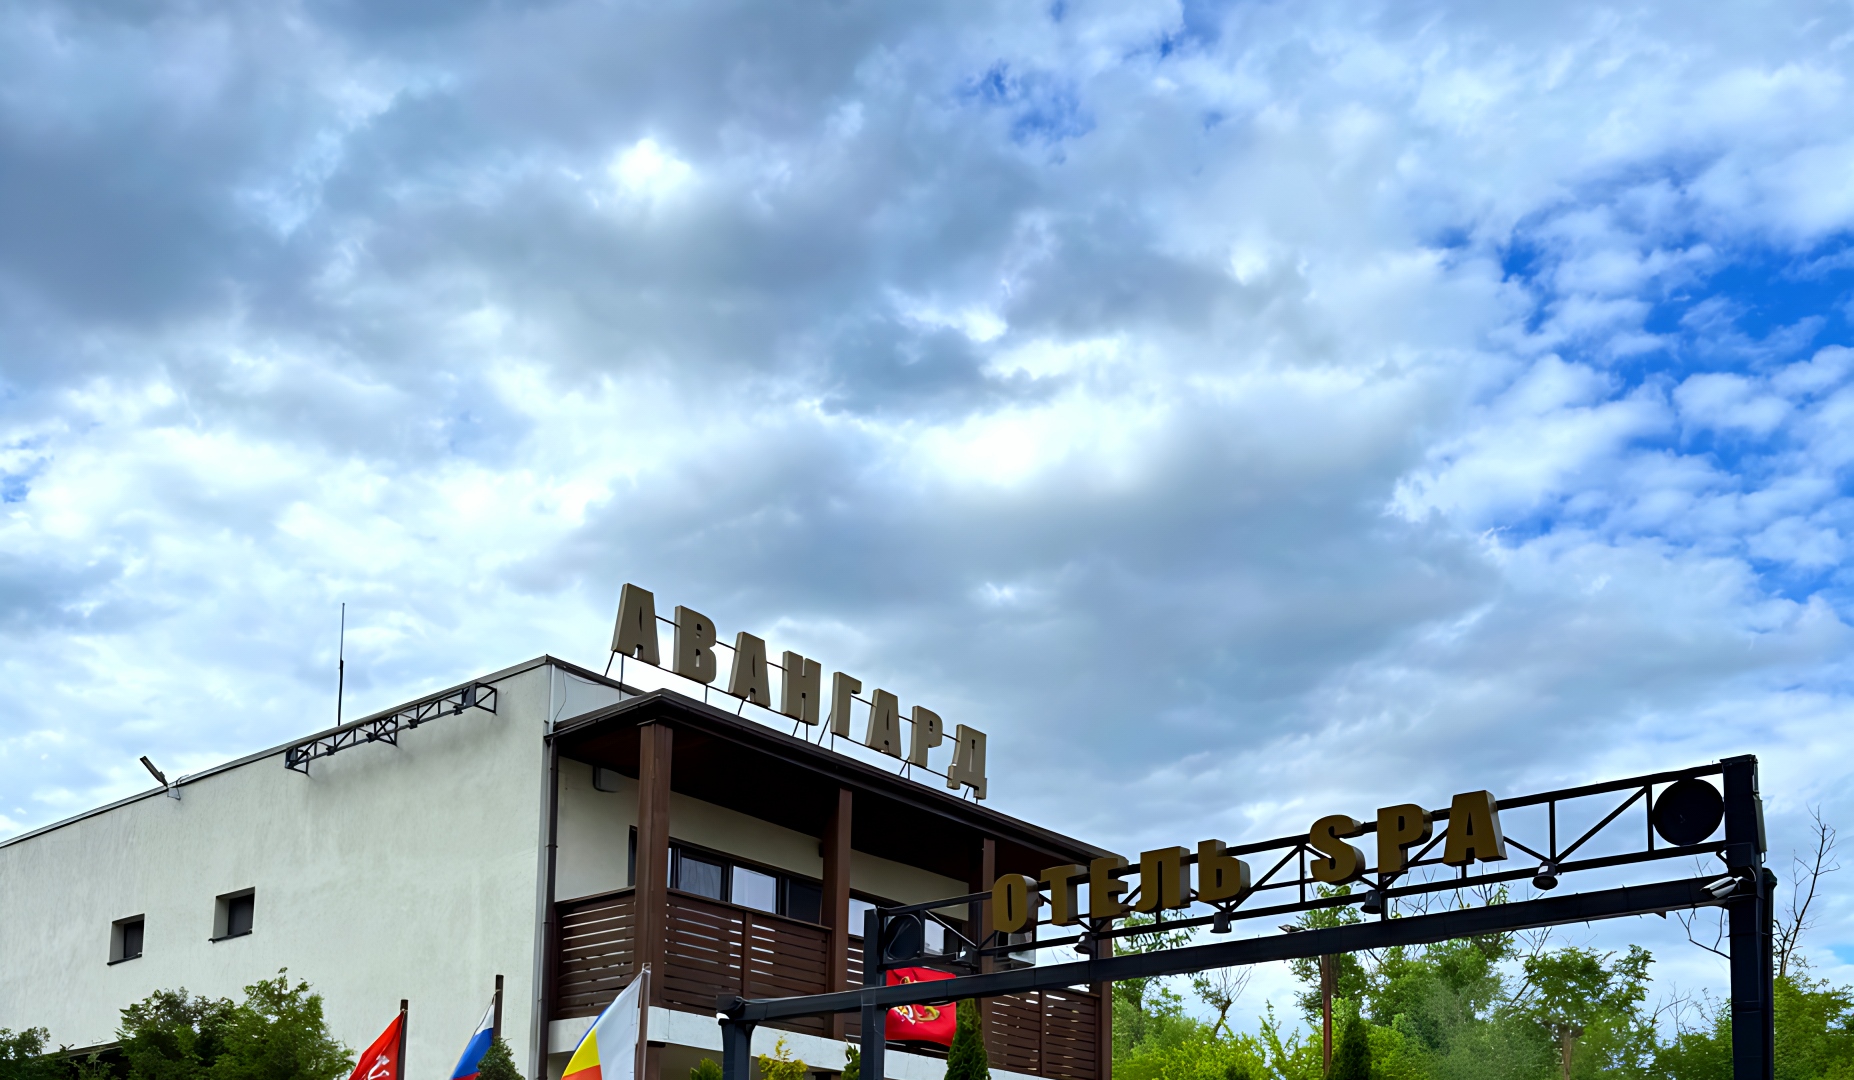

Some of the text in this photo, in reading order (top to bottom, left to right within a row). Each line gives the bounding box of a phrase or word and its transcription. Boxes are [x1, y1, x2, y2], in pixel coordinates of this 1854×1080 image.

[611, 582, 988, 800] АВАНГАРД
[992, 790, 1508, 934] ОТЕЛЬ SPA
